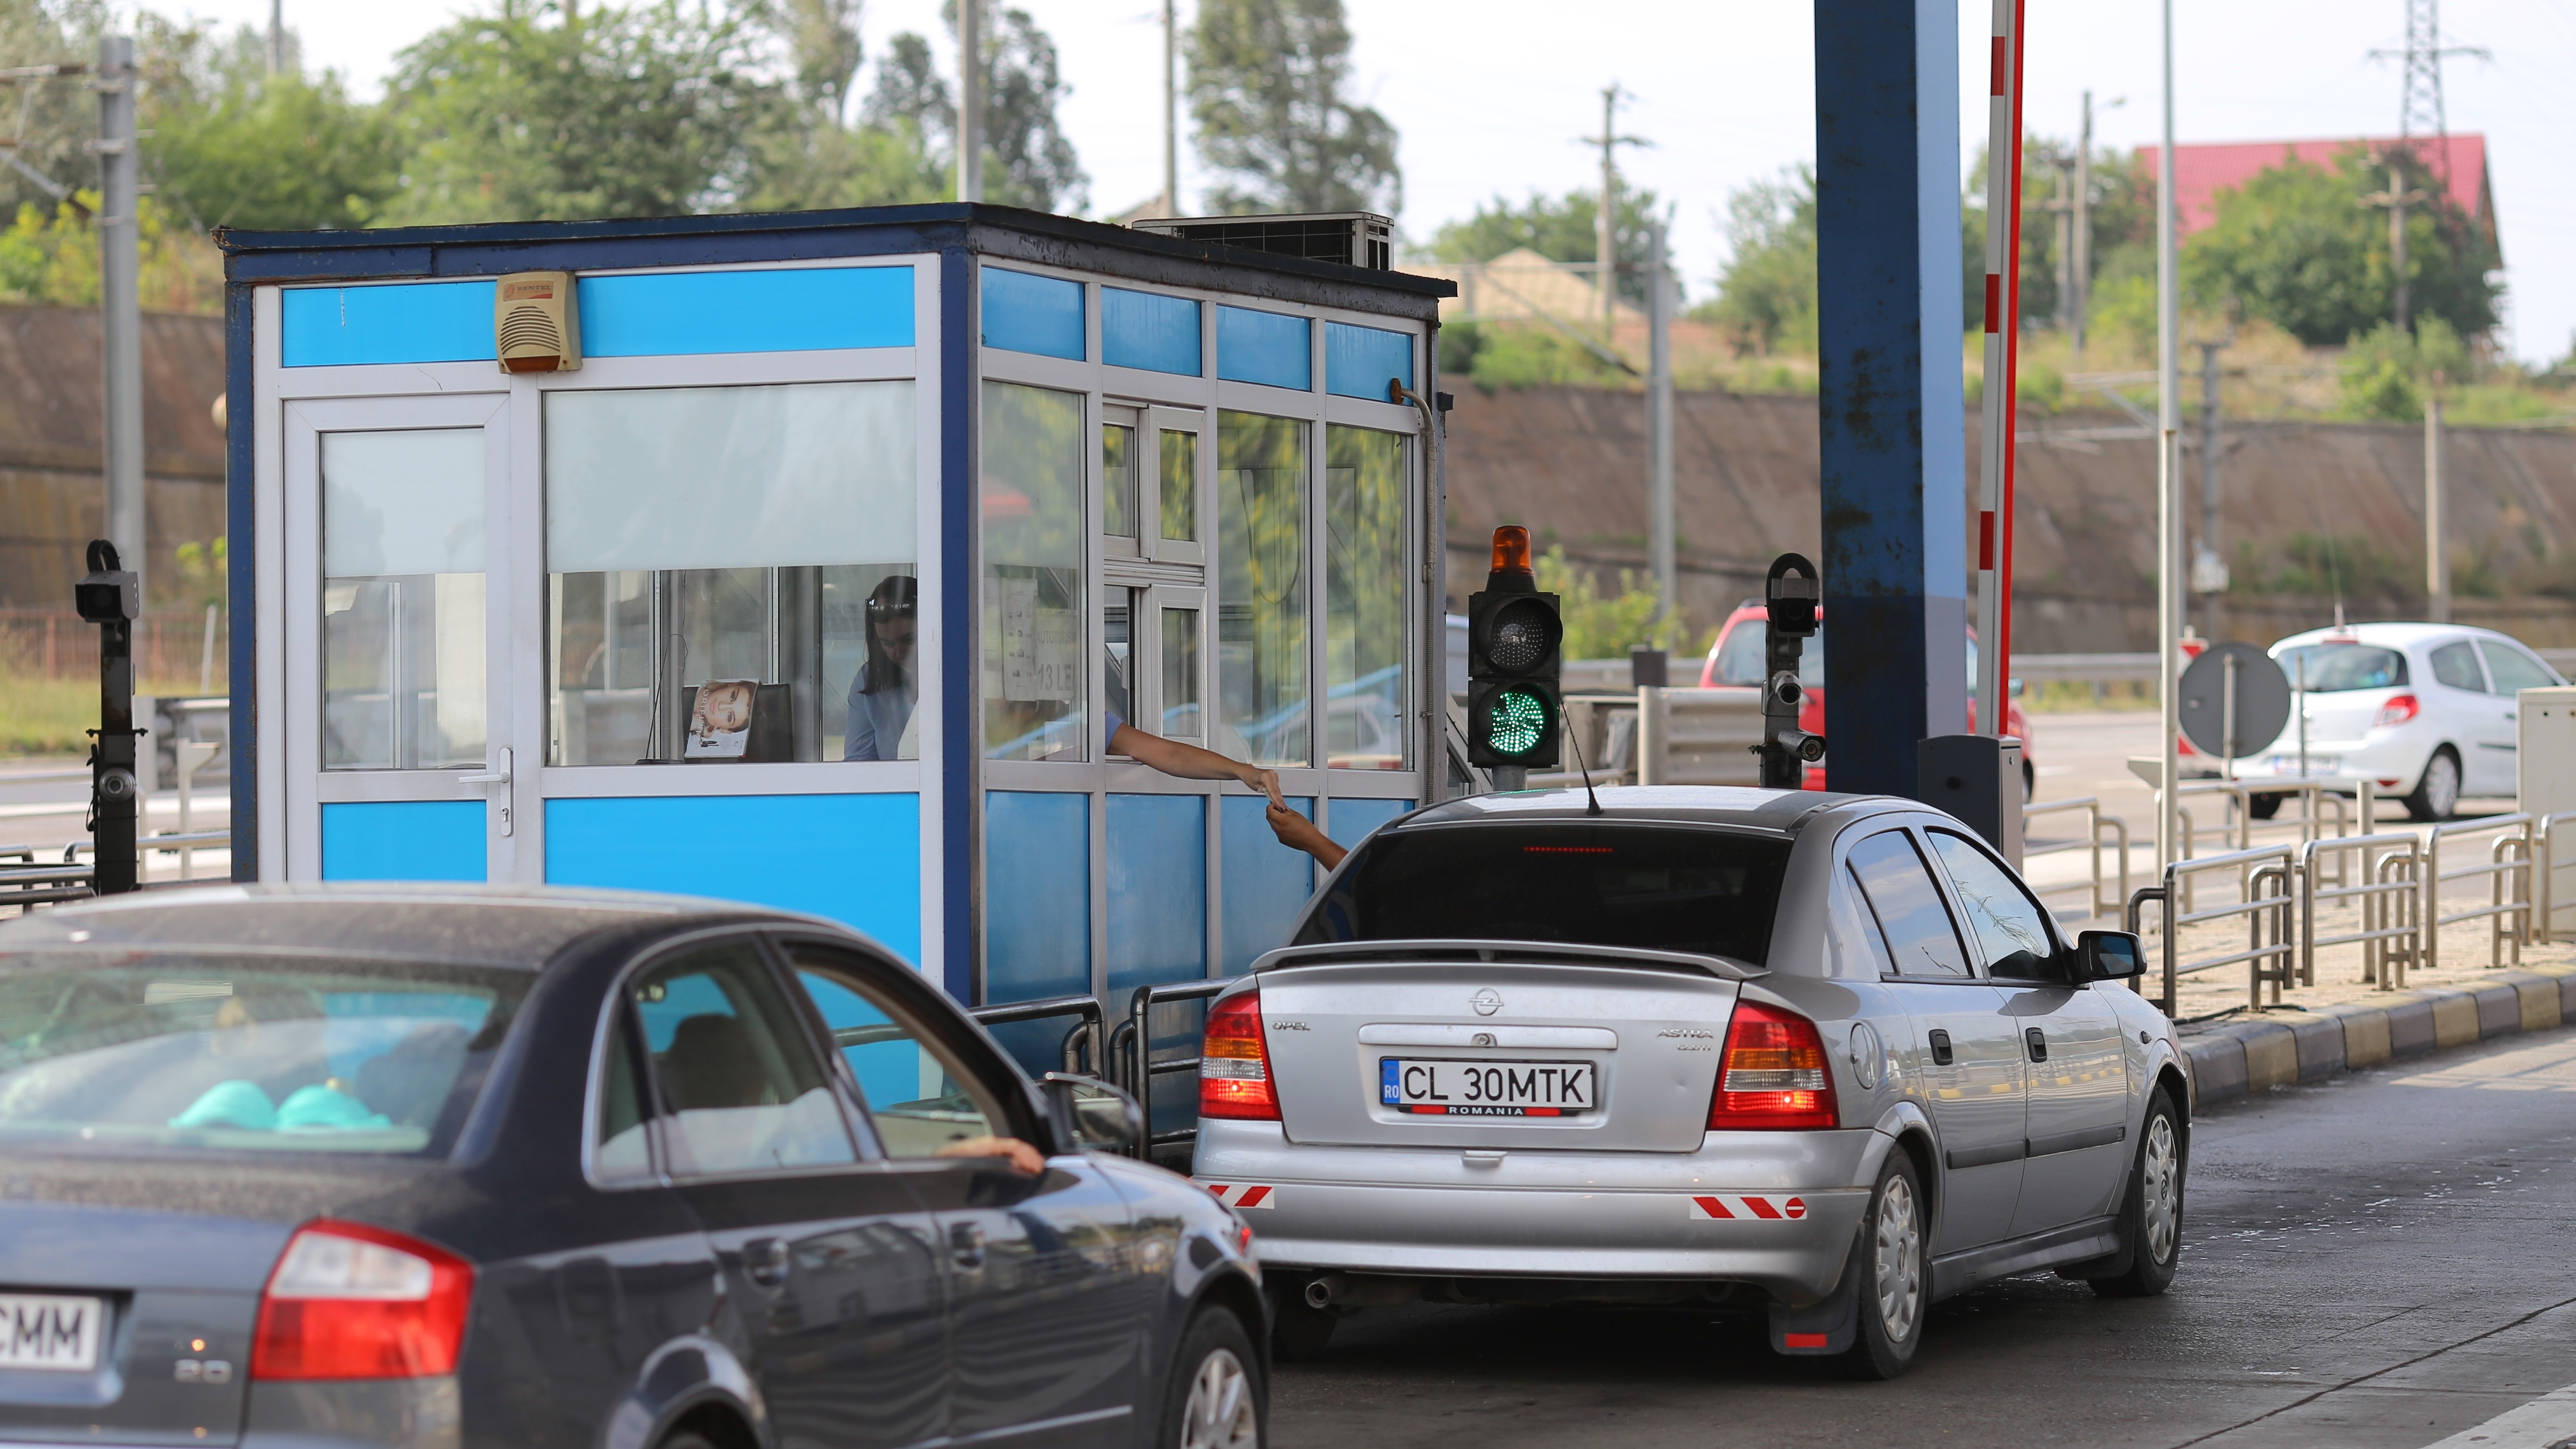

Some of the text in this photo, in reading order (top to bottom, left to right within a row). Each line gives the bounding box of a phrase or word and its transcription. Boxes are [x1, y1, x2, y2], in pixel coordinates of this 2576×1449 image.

[1038, 664, 1053, 691] 13
[695, 689, 709, 738] ORIFLAM
[1272, 1021, 1310, 1031] OPEL
[1657, 1028, 1714, 1038] ASTRA
[1385, 1084, 1399, 1098] RO
[1404, 1066, 1585, 1103] CL 30MTK
[1449, 1106, 1523, 1116] ROMANIA
